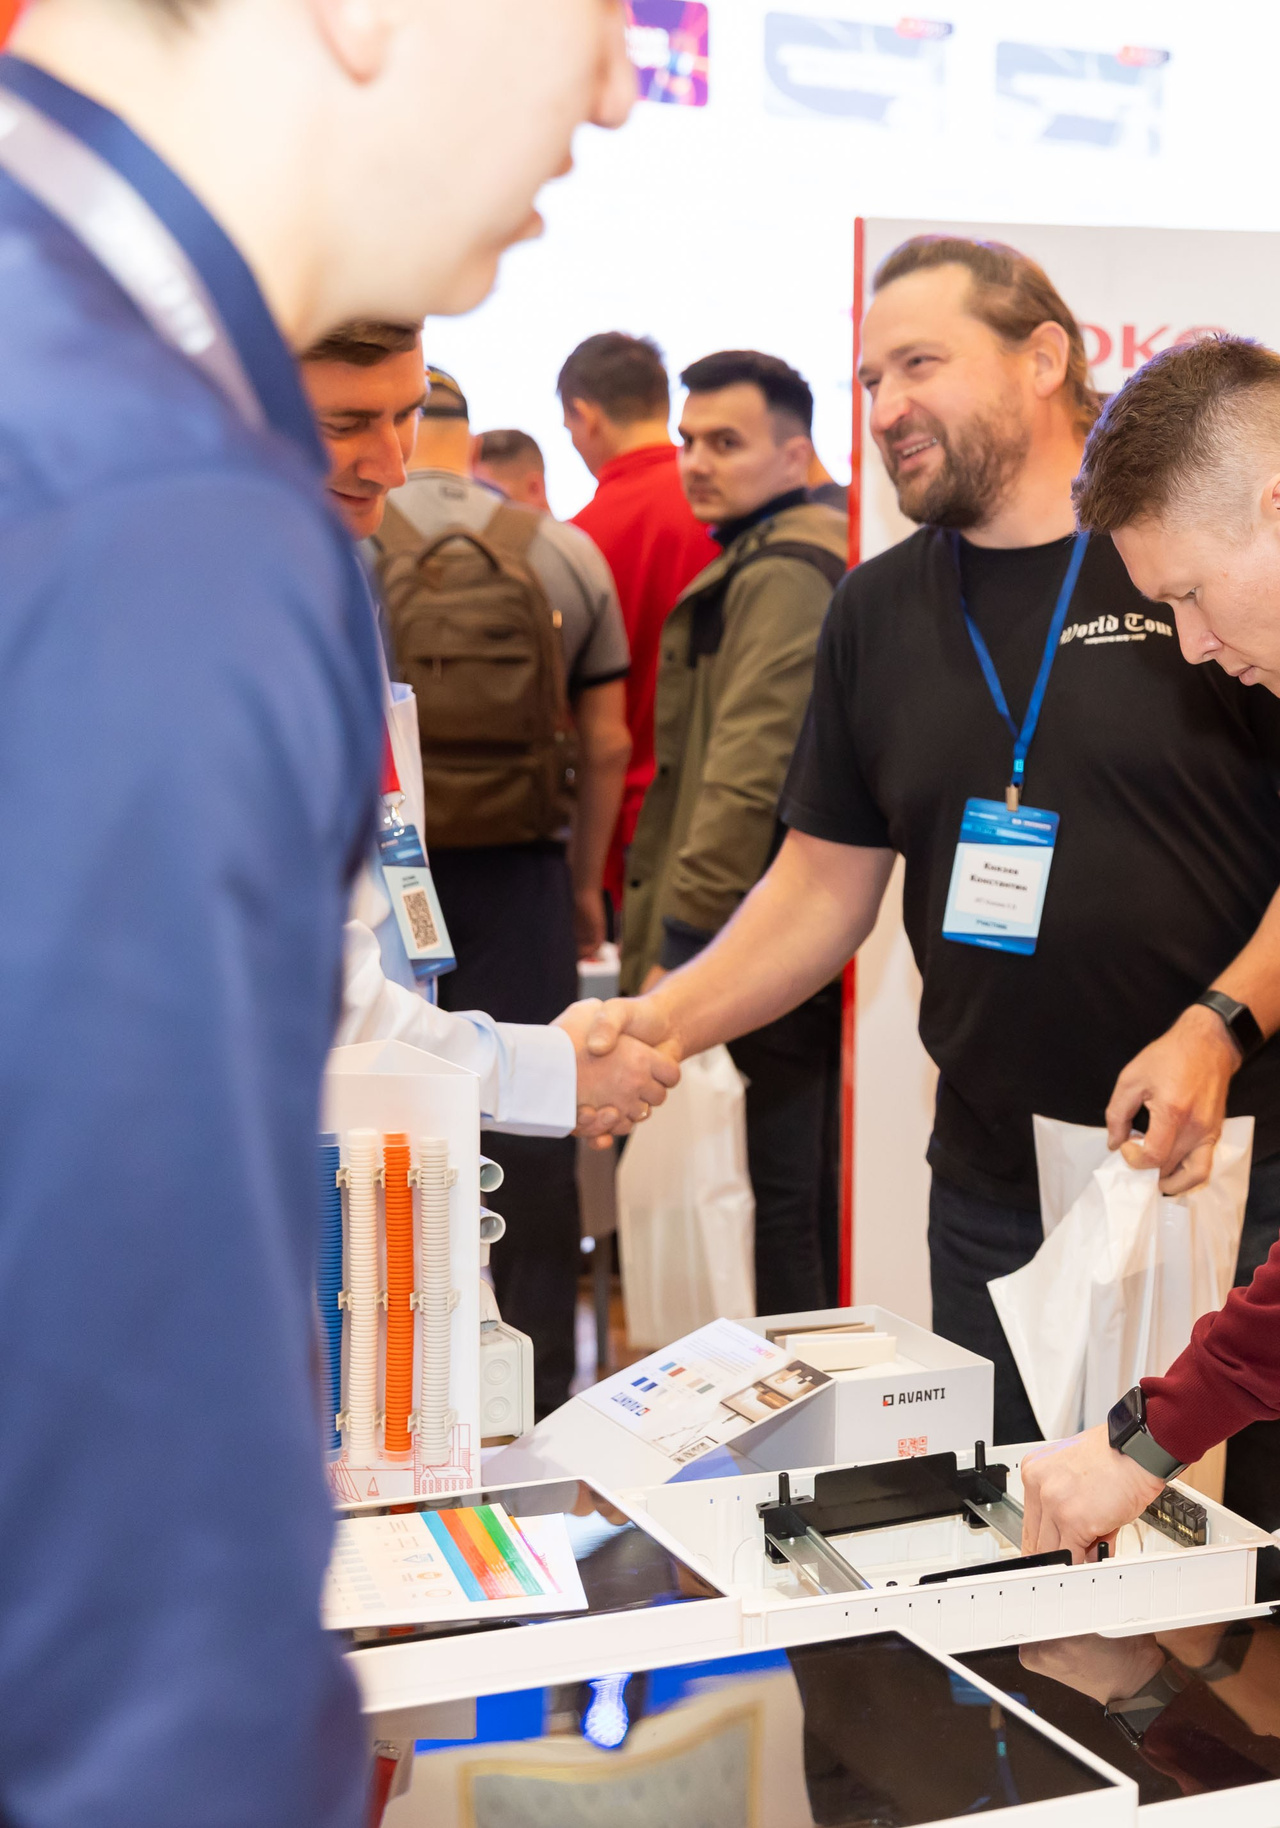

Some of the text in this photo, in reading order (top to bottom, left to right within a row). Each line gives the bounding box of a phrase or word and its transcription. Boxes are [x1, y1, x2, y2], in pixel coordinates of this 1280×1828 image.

[1078, 323, 1229, 369] DK
[1060, 614, 1119, 645] World
[1124, 612, 1173, 637] Tour
[899, 1387, 945, 1404] AVANTI
